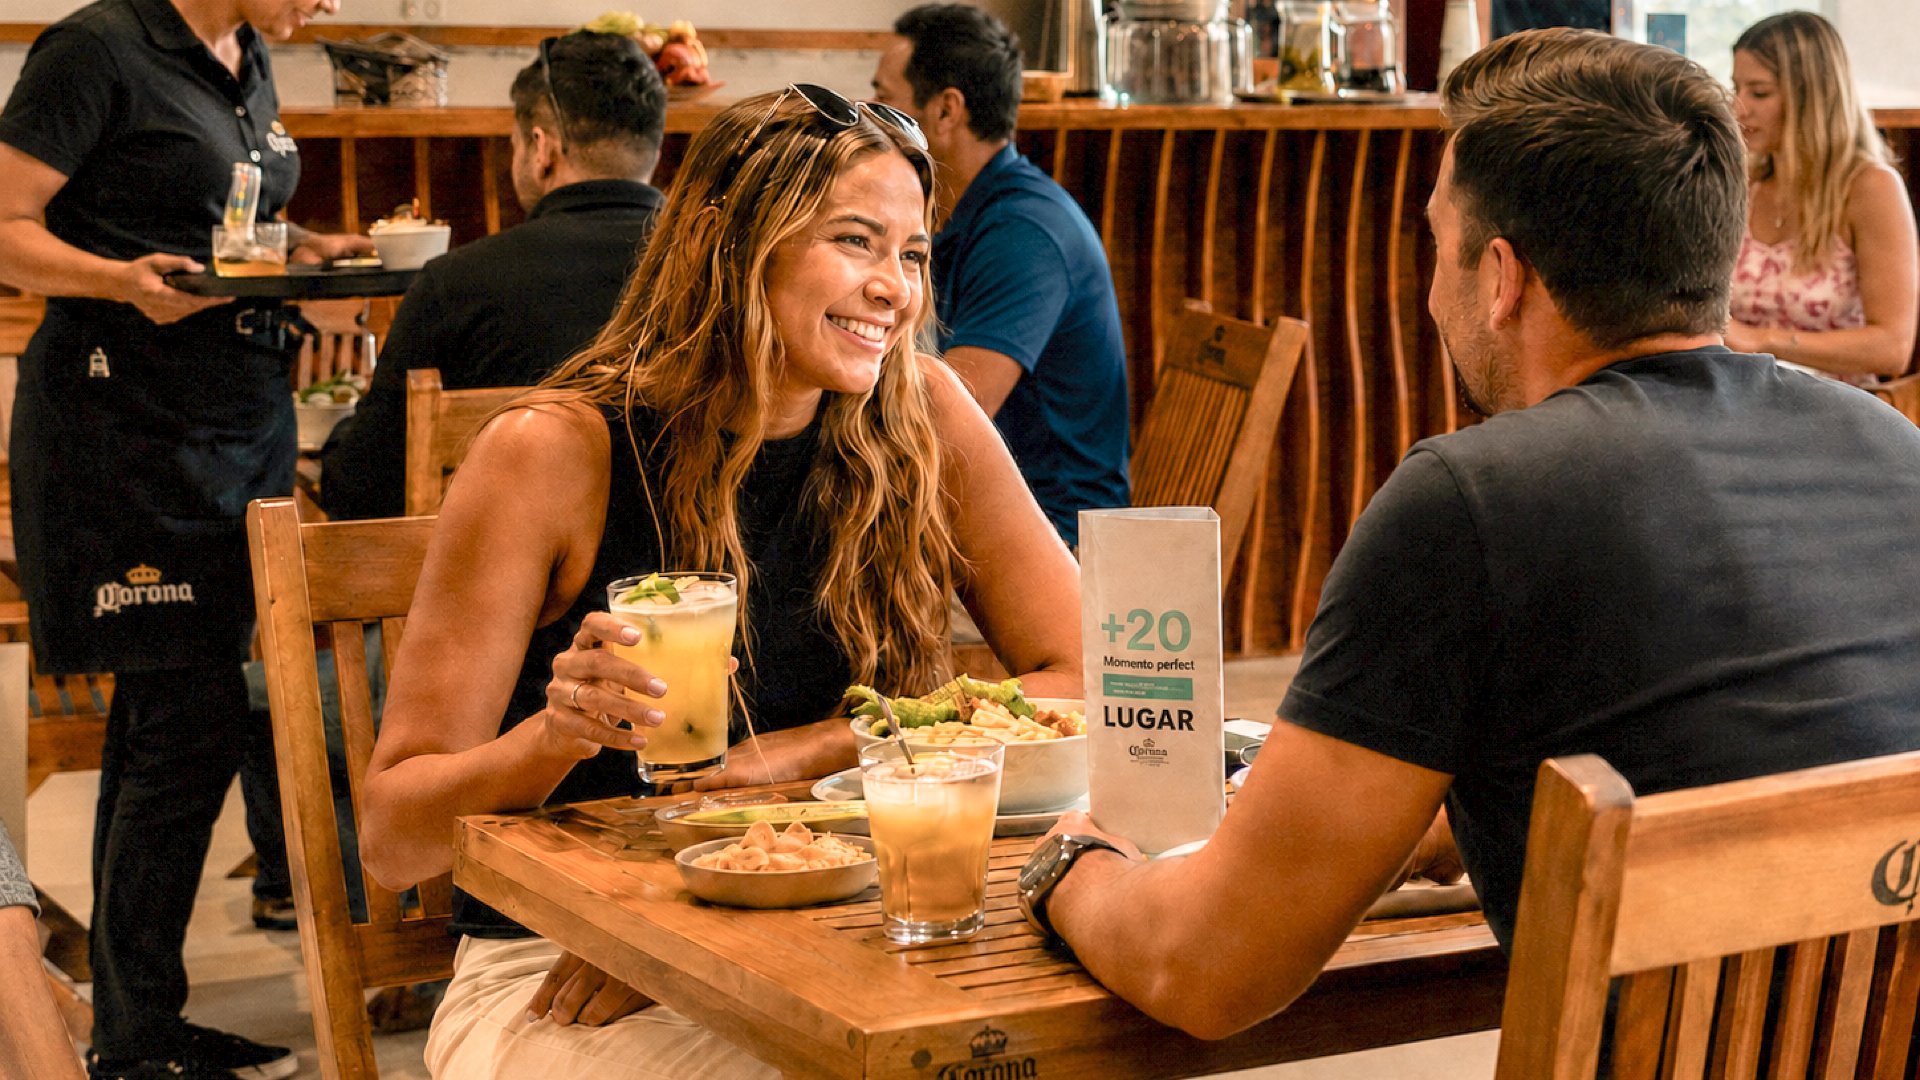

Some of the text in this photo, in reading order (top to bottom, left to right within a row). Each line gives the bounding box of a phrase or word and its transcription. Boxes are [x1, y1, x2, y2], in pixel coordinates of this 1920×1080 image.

[93, 581, 195, 618] Corona
[1101, 608, 1192, 652] +20
[1103, 655, 1195, 672] Momento perfect
[1103, 705, 1195, 731] LUGAR
